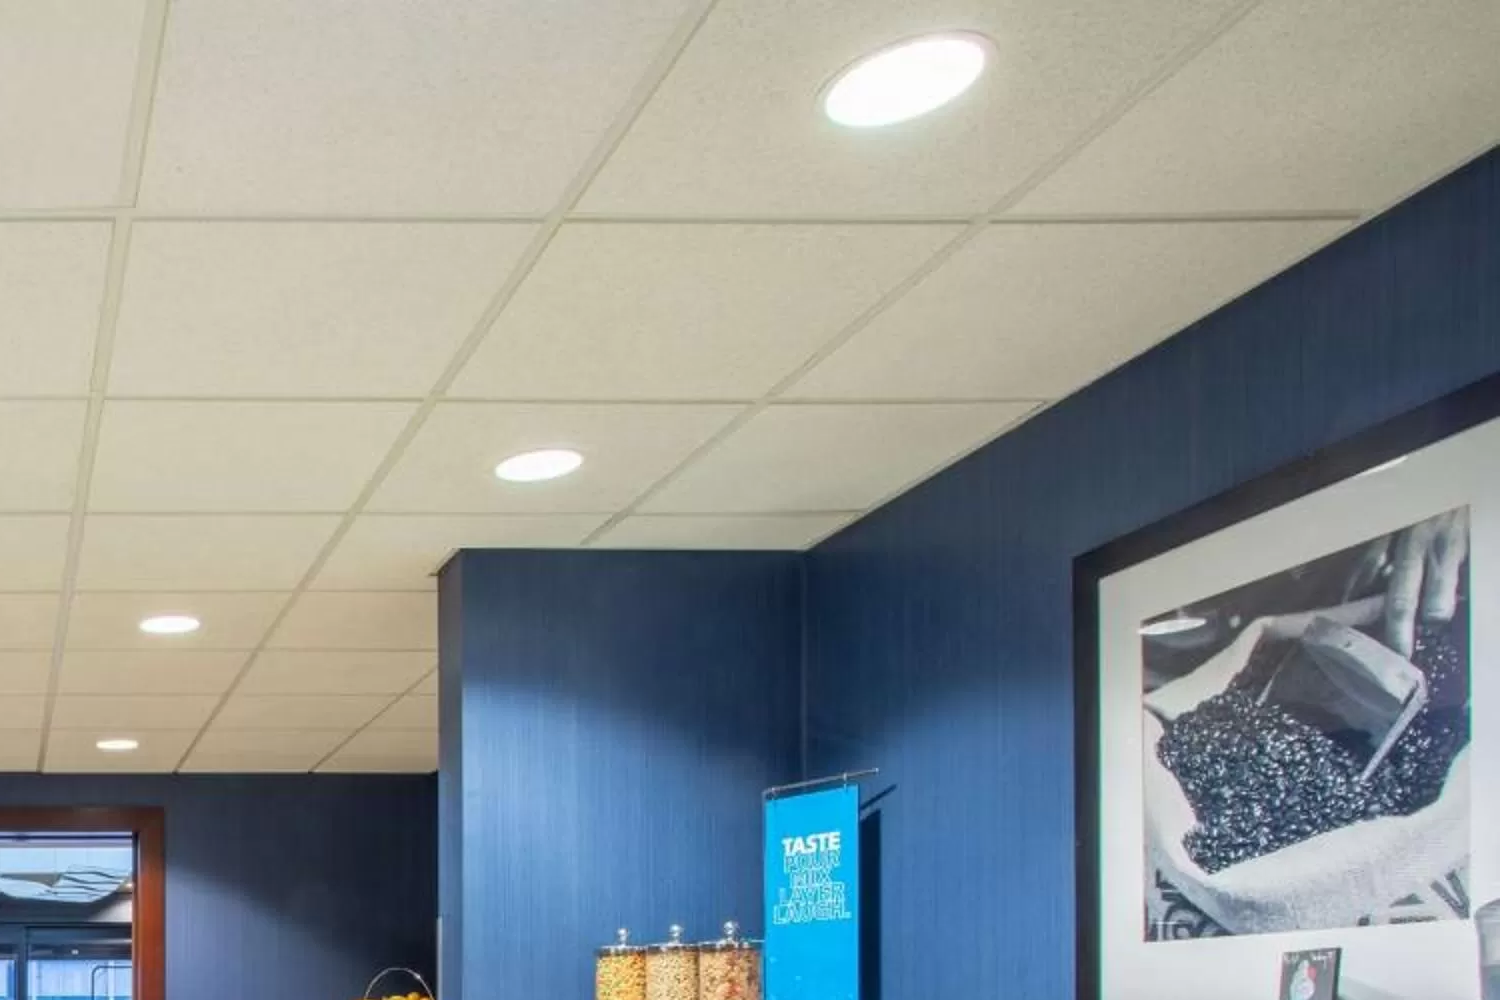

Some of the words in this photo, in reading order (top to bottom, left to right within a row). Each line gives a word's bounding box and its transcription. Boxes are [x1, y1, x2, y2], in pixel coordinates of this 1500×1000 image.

[781, 831, 841, 856] TASTE
[783, 849, 841, 873] POUR
[790, 867, 833, 889] MIX
[779, 881, 845, 906] LAYER
